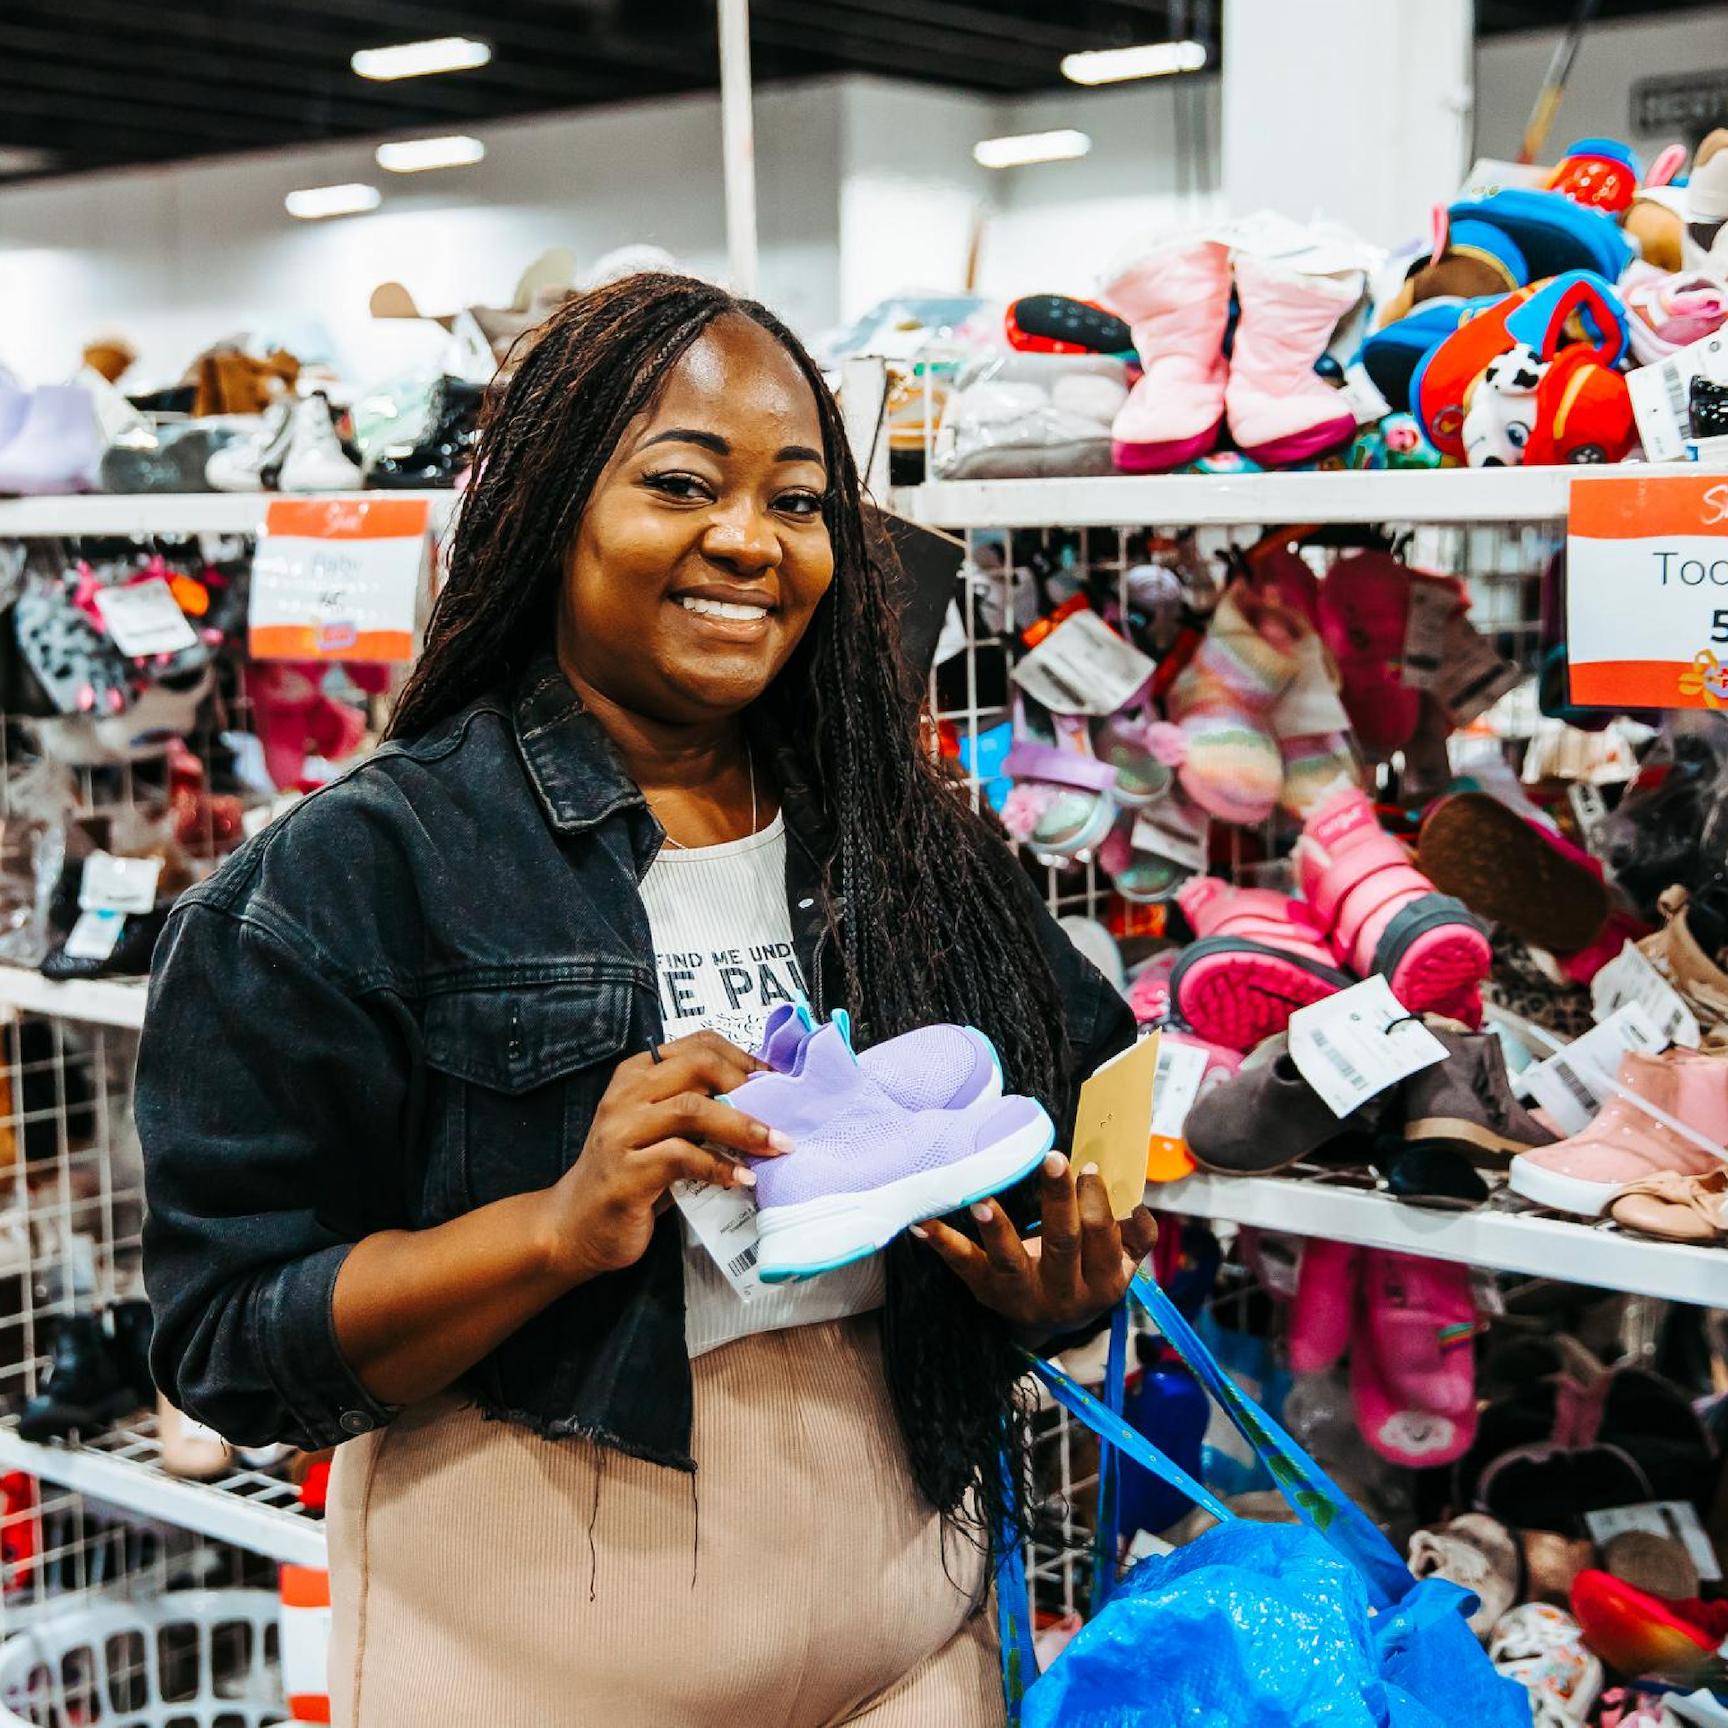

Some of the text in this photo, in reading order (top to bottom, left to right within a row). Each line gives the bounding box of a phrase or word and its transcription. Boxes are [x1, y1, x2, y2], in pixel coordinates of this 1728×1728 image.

[711, 949, 743, 966] ME
[748, 941, 796, 962] UND
[656, 970, 705, 1021] E
